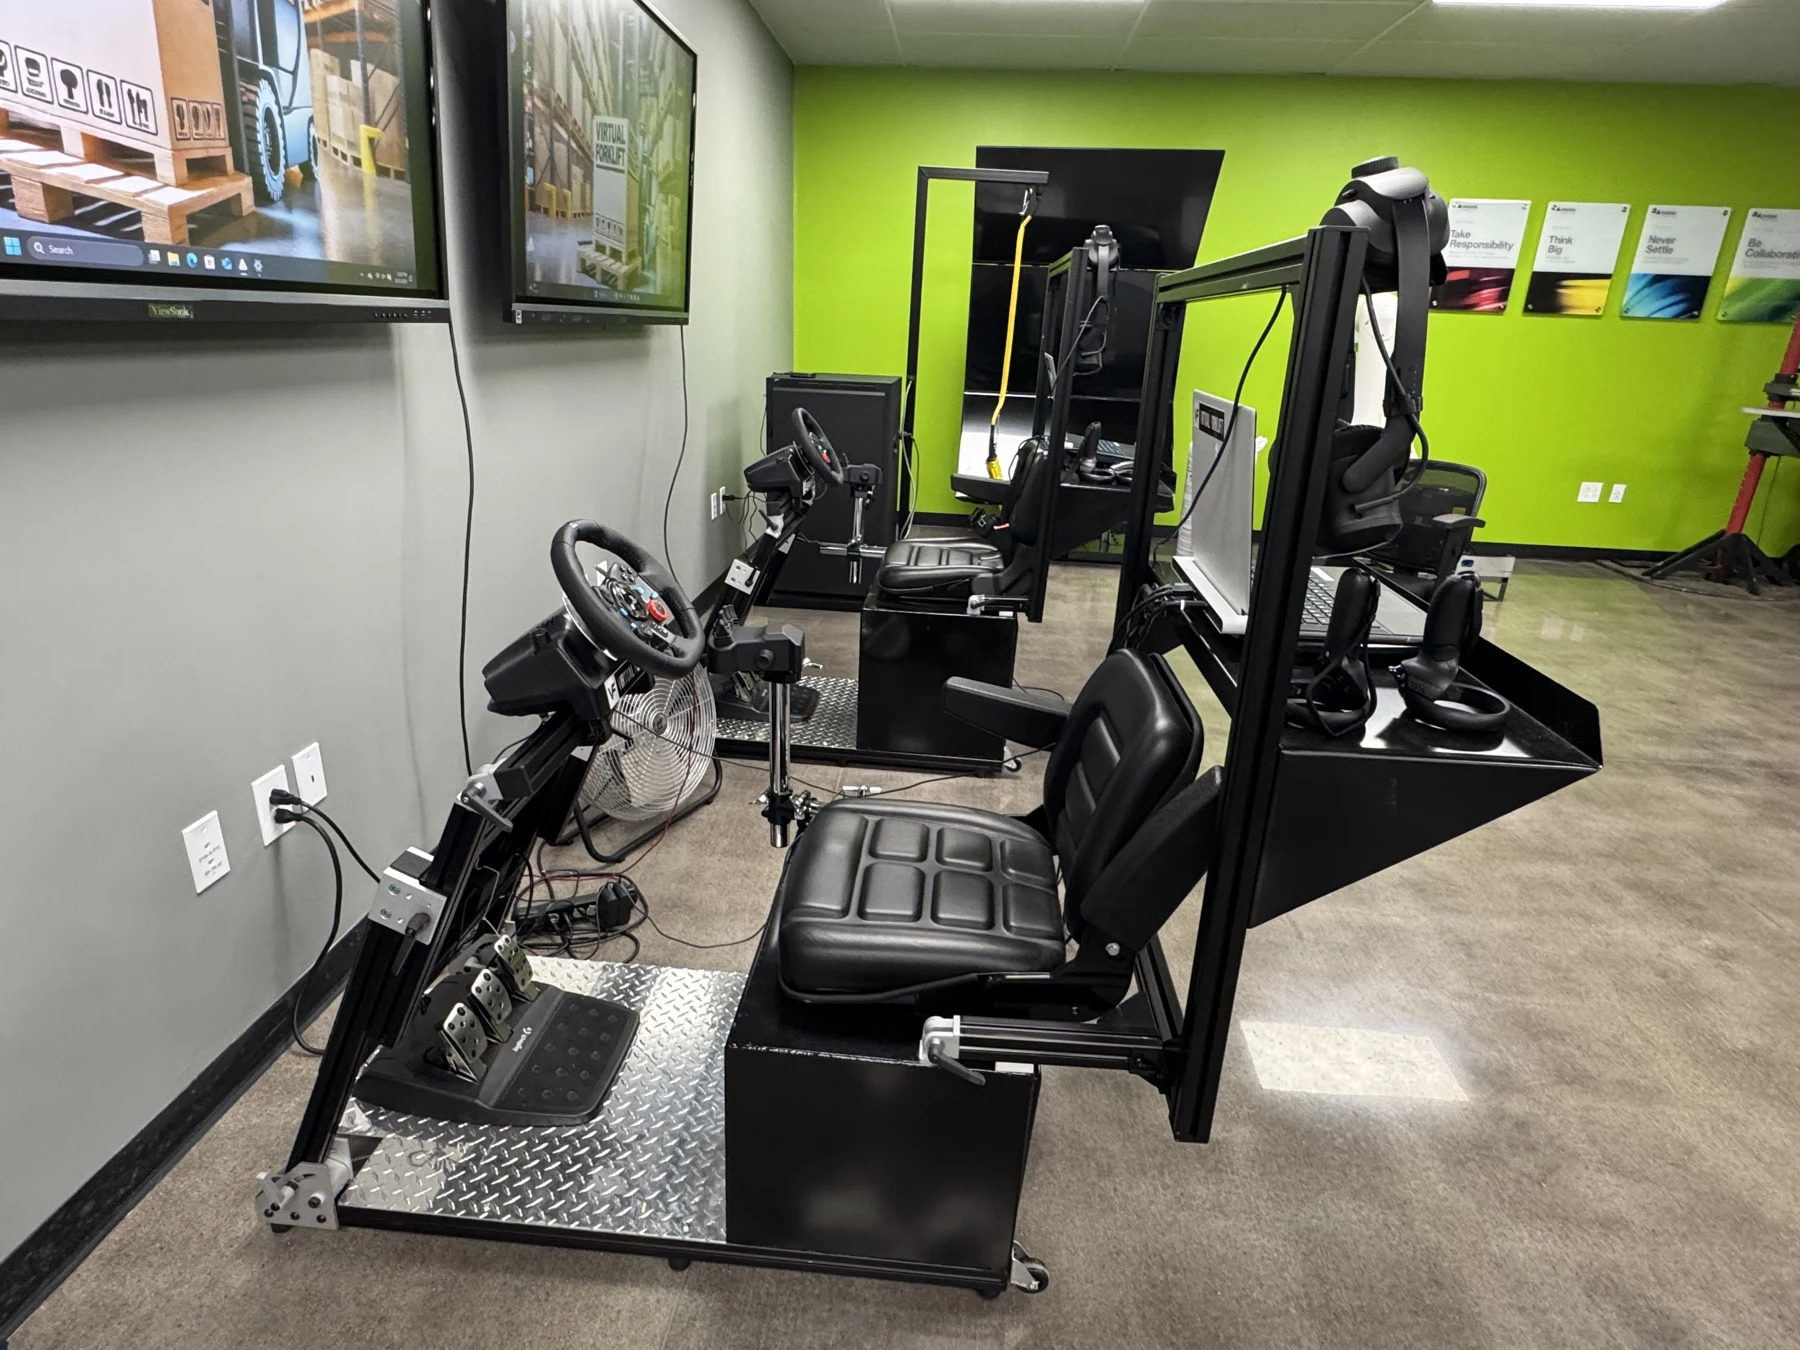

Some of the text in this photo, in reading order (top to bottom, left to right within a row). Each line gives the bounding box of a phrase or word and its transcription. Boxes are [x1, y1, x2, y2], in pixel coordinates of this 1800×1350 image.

[596, 121, 625, 145] VIRTUAL
[596, 143, 625, 167] FORKLIFT
[1450, 229, 1471, 239] Take
[1449, 239, 1514, 252] Responsibility
[1549, 235, 1573, 245] Think
[1647, 235, 1677, 245] Never
[1748, 238, 1763, 248] Be
[48, 244, 74, 256] Search
[1547, 244, 1563, 256] Big
[1645, 245, 1674, 255] Settle
